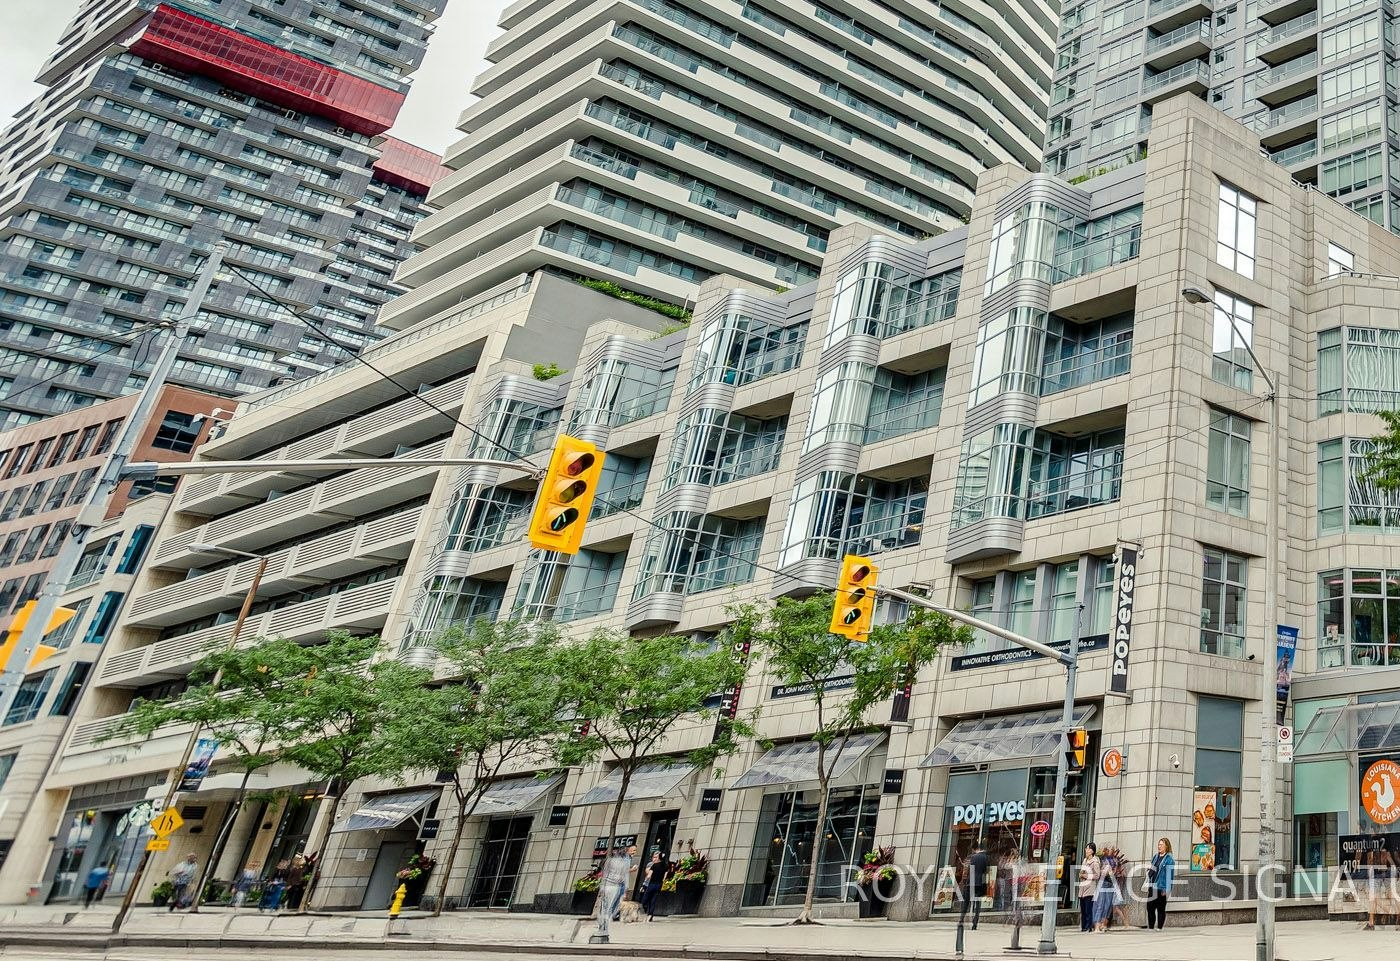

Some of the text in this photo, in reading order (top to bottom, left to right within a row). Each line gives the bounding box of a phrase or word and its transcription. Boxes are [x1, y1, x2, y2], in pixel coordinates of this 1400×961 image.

[961, 655, 991, 667] INNOVATIVE
[991, 649, 1032, 663] ORTHODONTICS
[1367, 763, 1400, 782] LOUISIANA
[1370, 805, 1400, 821] KITCHEN
